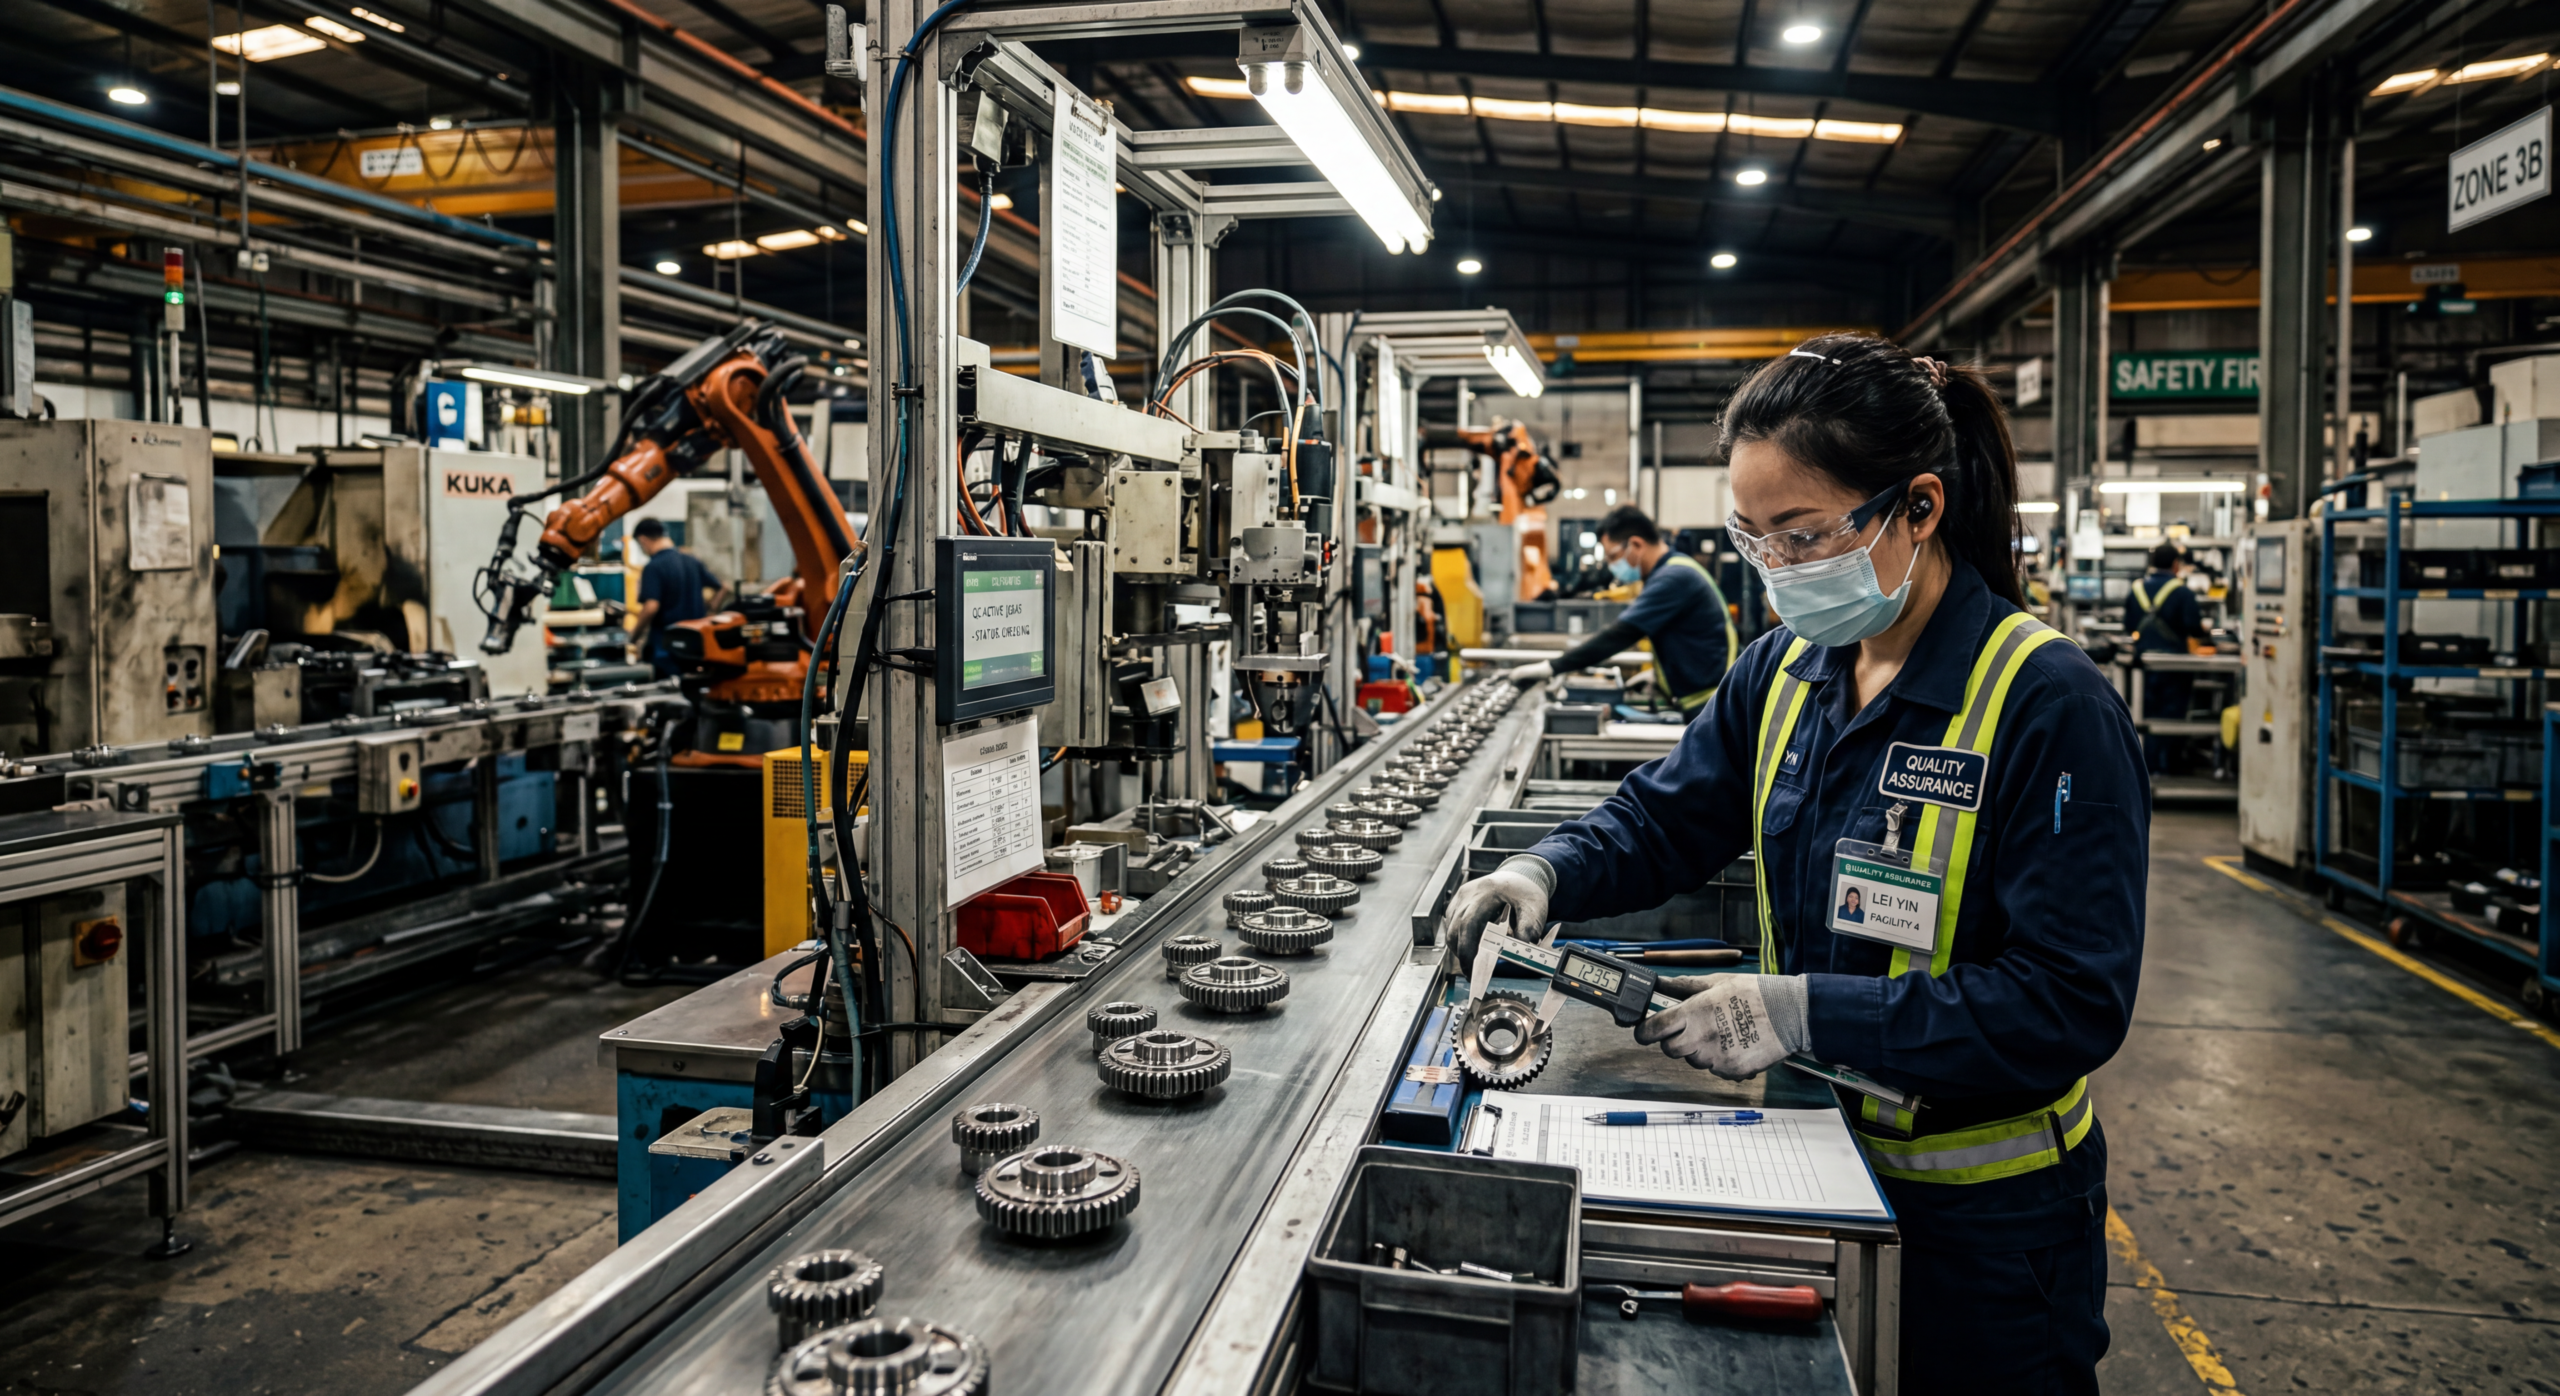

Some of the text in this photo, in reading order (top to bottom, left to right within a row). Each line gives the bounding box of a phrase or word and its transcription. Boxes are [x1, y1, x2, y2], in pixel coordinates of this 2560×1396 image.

[2454, 138, 2543, 212] ZONE 3B
[2116, 358, 2216, 392] SAFETY
[447, 473, 513, 495] KUKA
[1906, 754, 1965, 777] QUALITY
[1887, 771, 1975, 800] ASSURANCE
[1872, 892, 1919, 913] LEI YIN
[1913, 922, 1920, 931] 4
